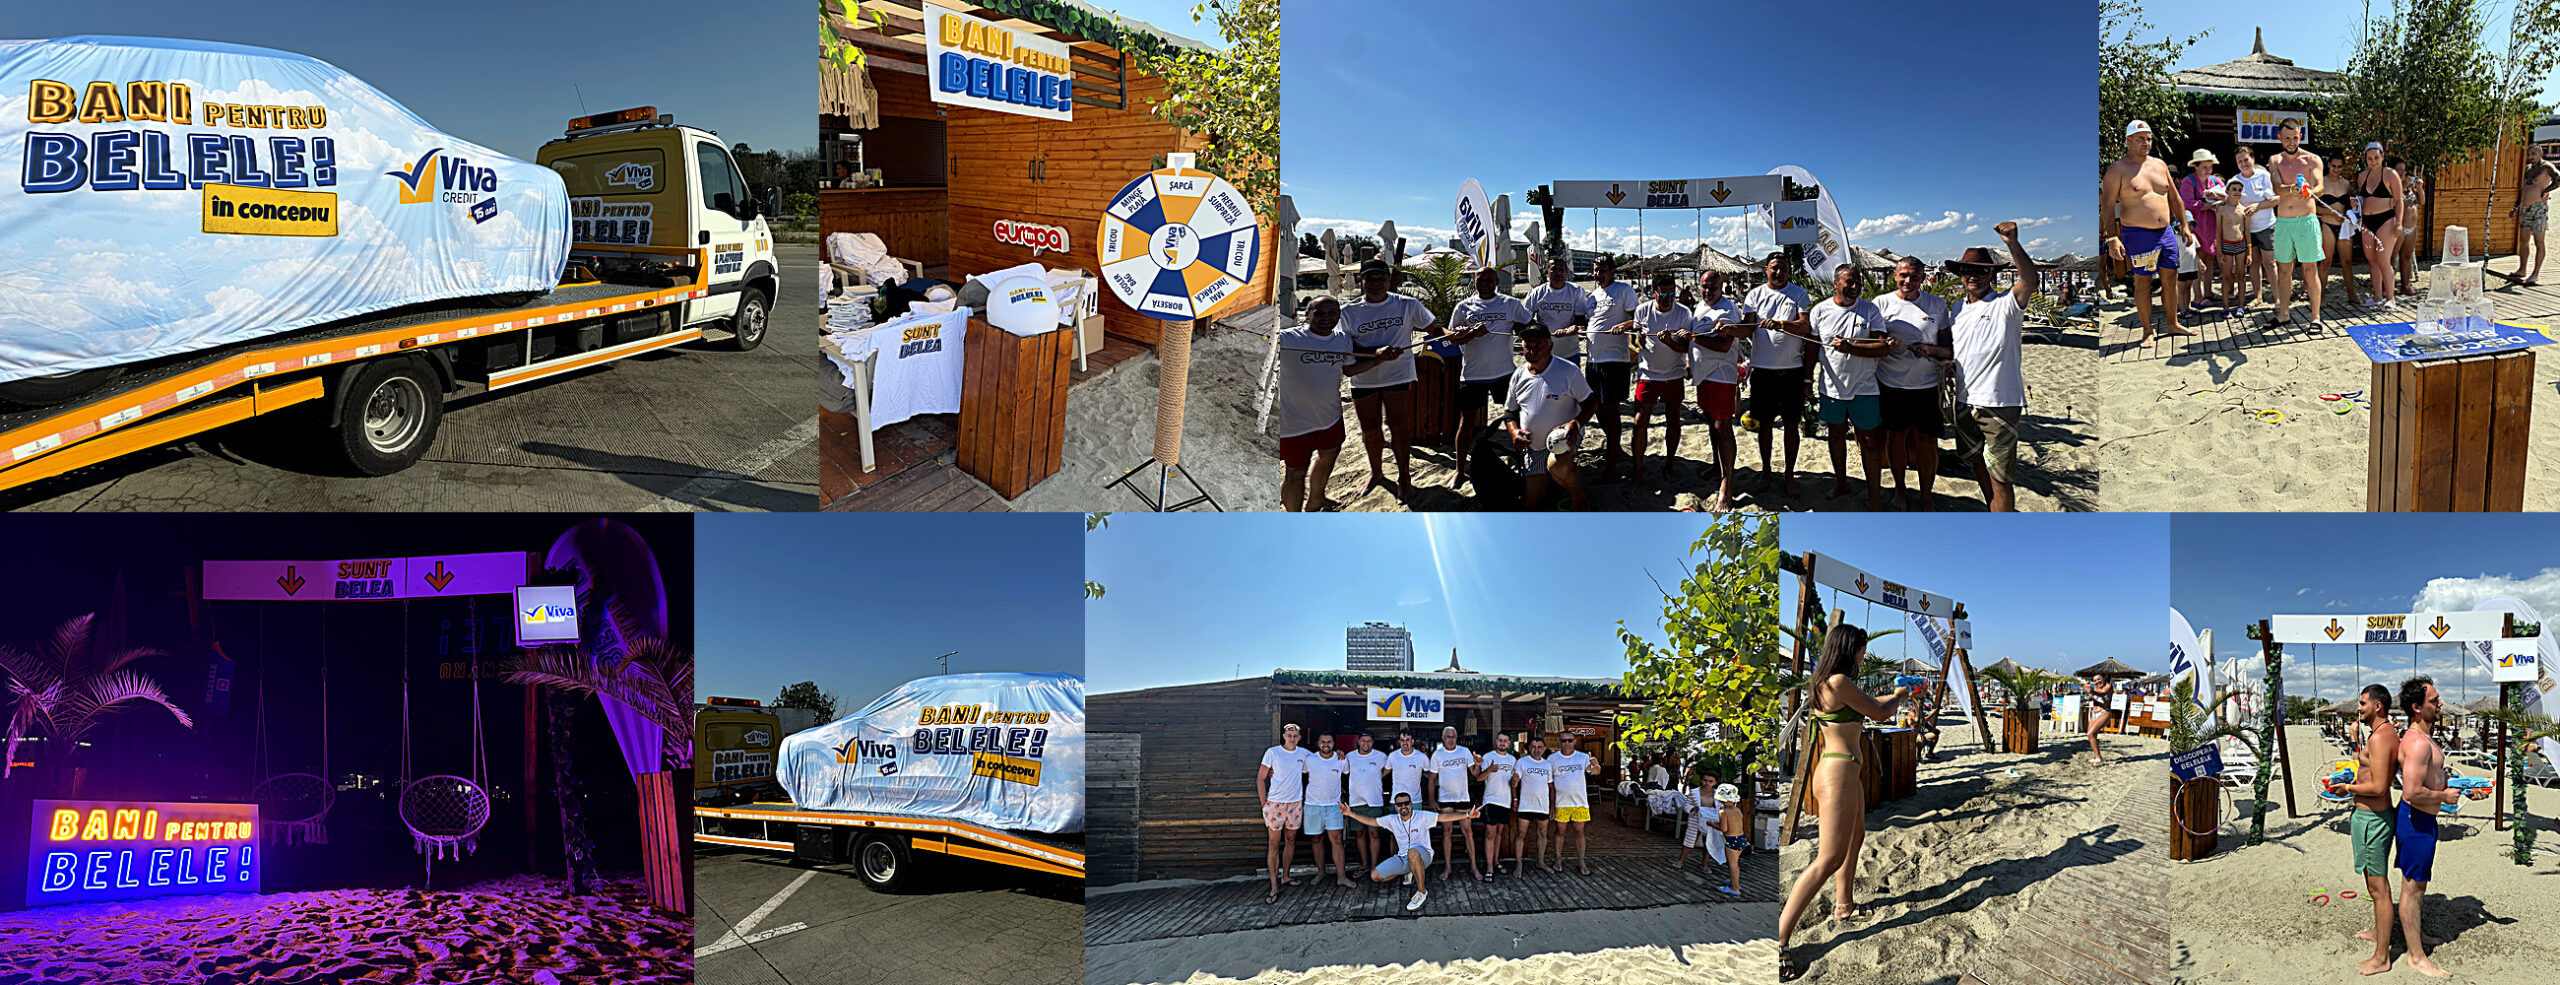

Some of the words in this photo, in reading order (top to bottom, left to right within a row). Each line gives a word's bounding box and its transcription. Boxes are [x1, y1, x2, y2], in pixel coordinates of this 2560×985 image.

[940, 13, 1014, 60] BANI
[1014, 46, 1070, 76] PENTRU
[940, 51, 1071, 112] BELELE!
[28, 79, 192, 125] BANI
[202, 101, 327, 129] PENTRU
[21, 131, 337, 193] BELELE!
[627, 166, 651, 177] Viva
[440, 156, 497, 192] Viva
[442, 191, 478, 203] CREDIT
[1648, 180, 1687, 194] SUNT
[1120, 188, 1143, 208] MINGE
[1218, 191, 1242, 218] PREMIU
[1646, 194, 1689, 207] BELEA
[571, 200, 600, 217] ANI
[602, 205, 650, 217] PENTRU
[1794, 216, 1815, 226] Viva
[572, 220, 650, 244] ELELE!
[1108, 228, 1118, 253] TRICOU
[1165, 226, 1177, 249] Viva
[1234, 240, 1246, 267] TRICOU
[1113, 273, 1134, 296] COOLER
[1123, 273, 1137, 287] BAG
[1211, 290, 1225, 303] MAI
[902, 323, 941, 343] SUNT
[899, 338, 942, 359] BELEA
[337, 560, 392, 579] SUNT
[335, 580, 394, 598] BELEA
[545, 605, 574, 618] Viva
[2366, 615, 2406, 629] SUNT
[2365, 630, 2407, 642] BELEA
[2514, 654, 2535, 664] Viva
[1403, 695, 1441, 712] Viva
[919, 705, 981, 725] BANI
[983, 711, 1050, 724] PENTRU
[859, 740, 896, 758] Viva
[913, 727, 1048, 757] BELELE!
[50, 809, 159, 841] BANI
[165, 822, 251, 840] PENTRU
[42, 847, 252, 892] BELELE!
